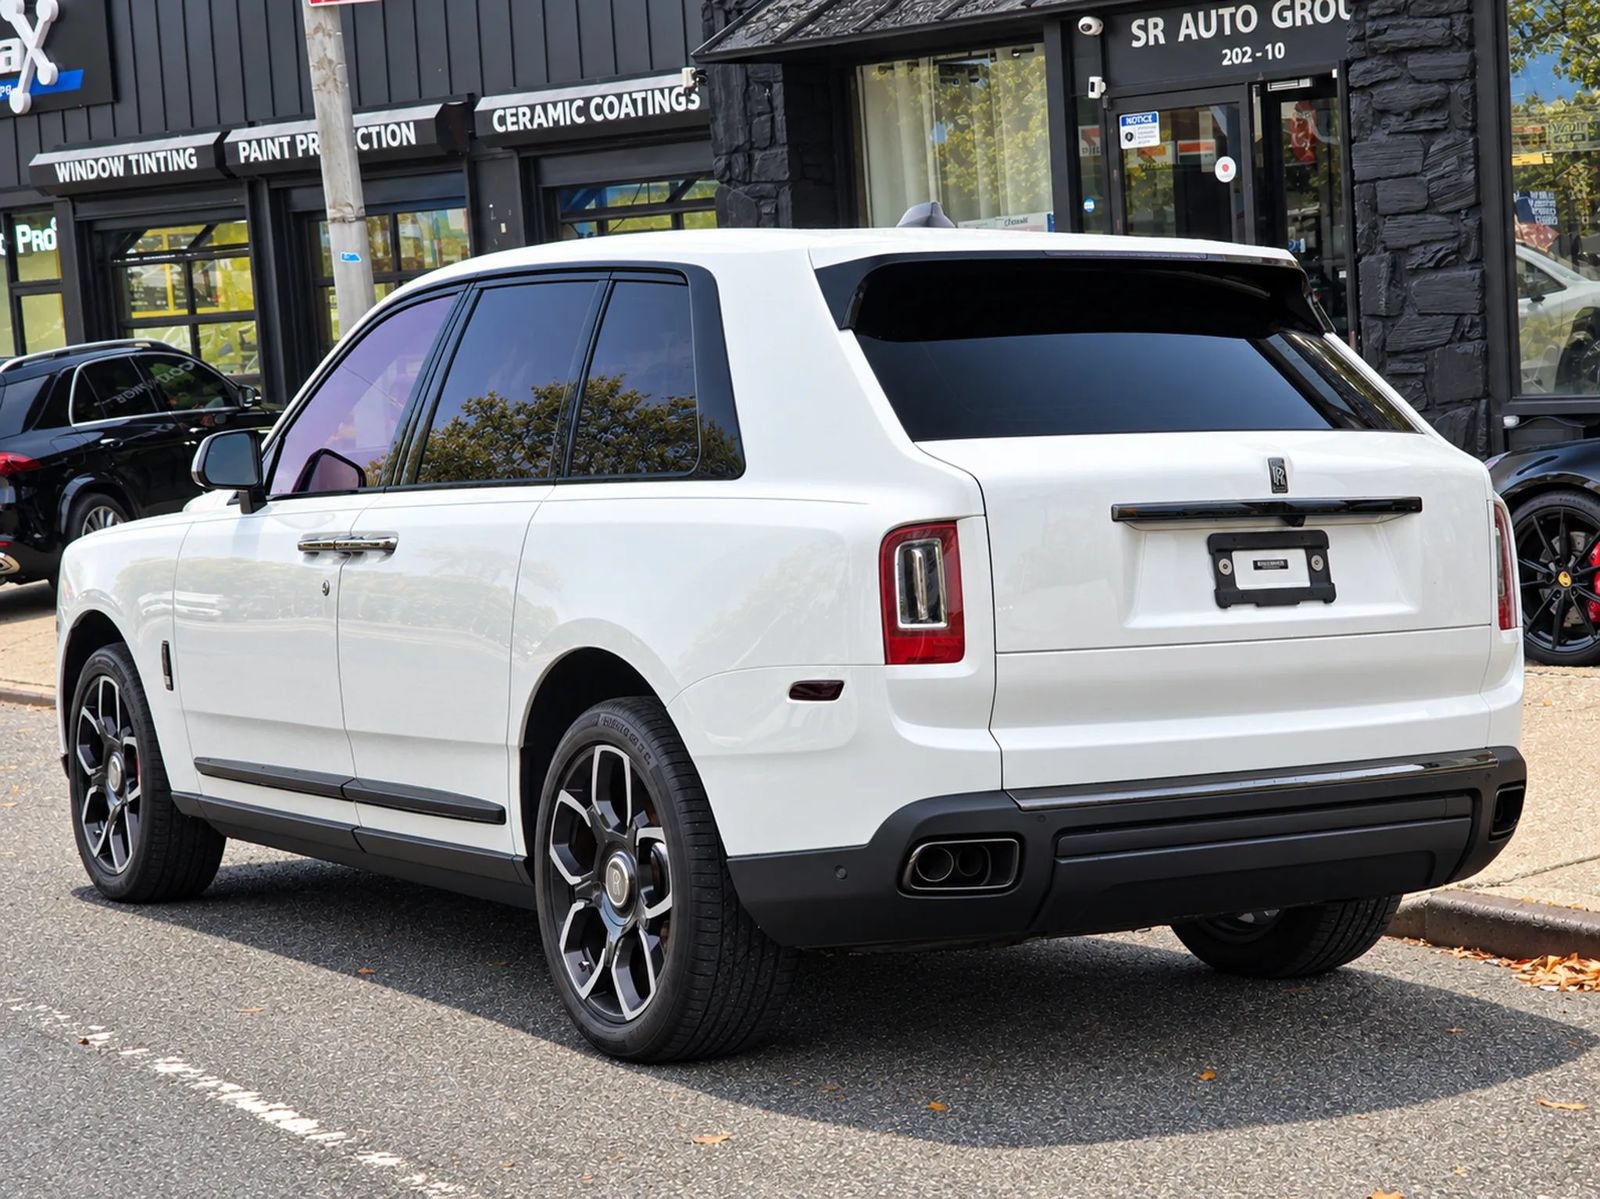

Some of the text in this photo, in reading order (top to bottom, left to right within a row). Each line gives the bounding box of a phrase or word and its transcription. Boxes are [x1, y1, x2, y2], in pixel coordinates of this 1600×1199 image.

[1131, 17, 1165, 48] SR
[1177, 4, 1258, 42] AUTO
[492, 86, 701, 132] CERAMIC COATINGS
[1126, 115, 1152, 125] NOTICE
[238, 121, 417, 164] PAINT PRCTION
[55, 147, 198, 184] WINDOW TINTING
